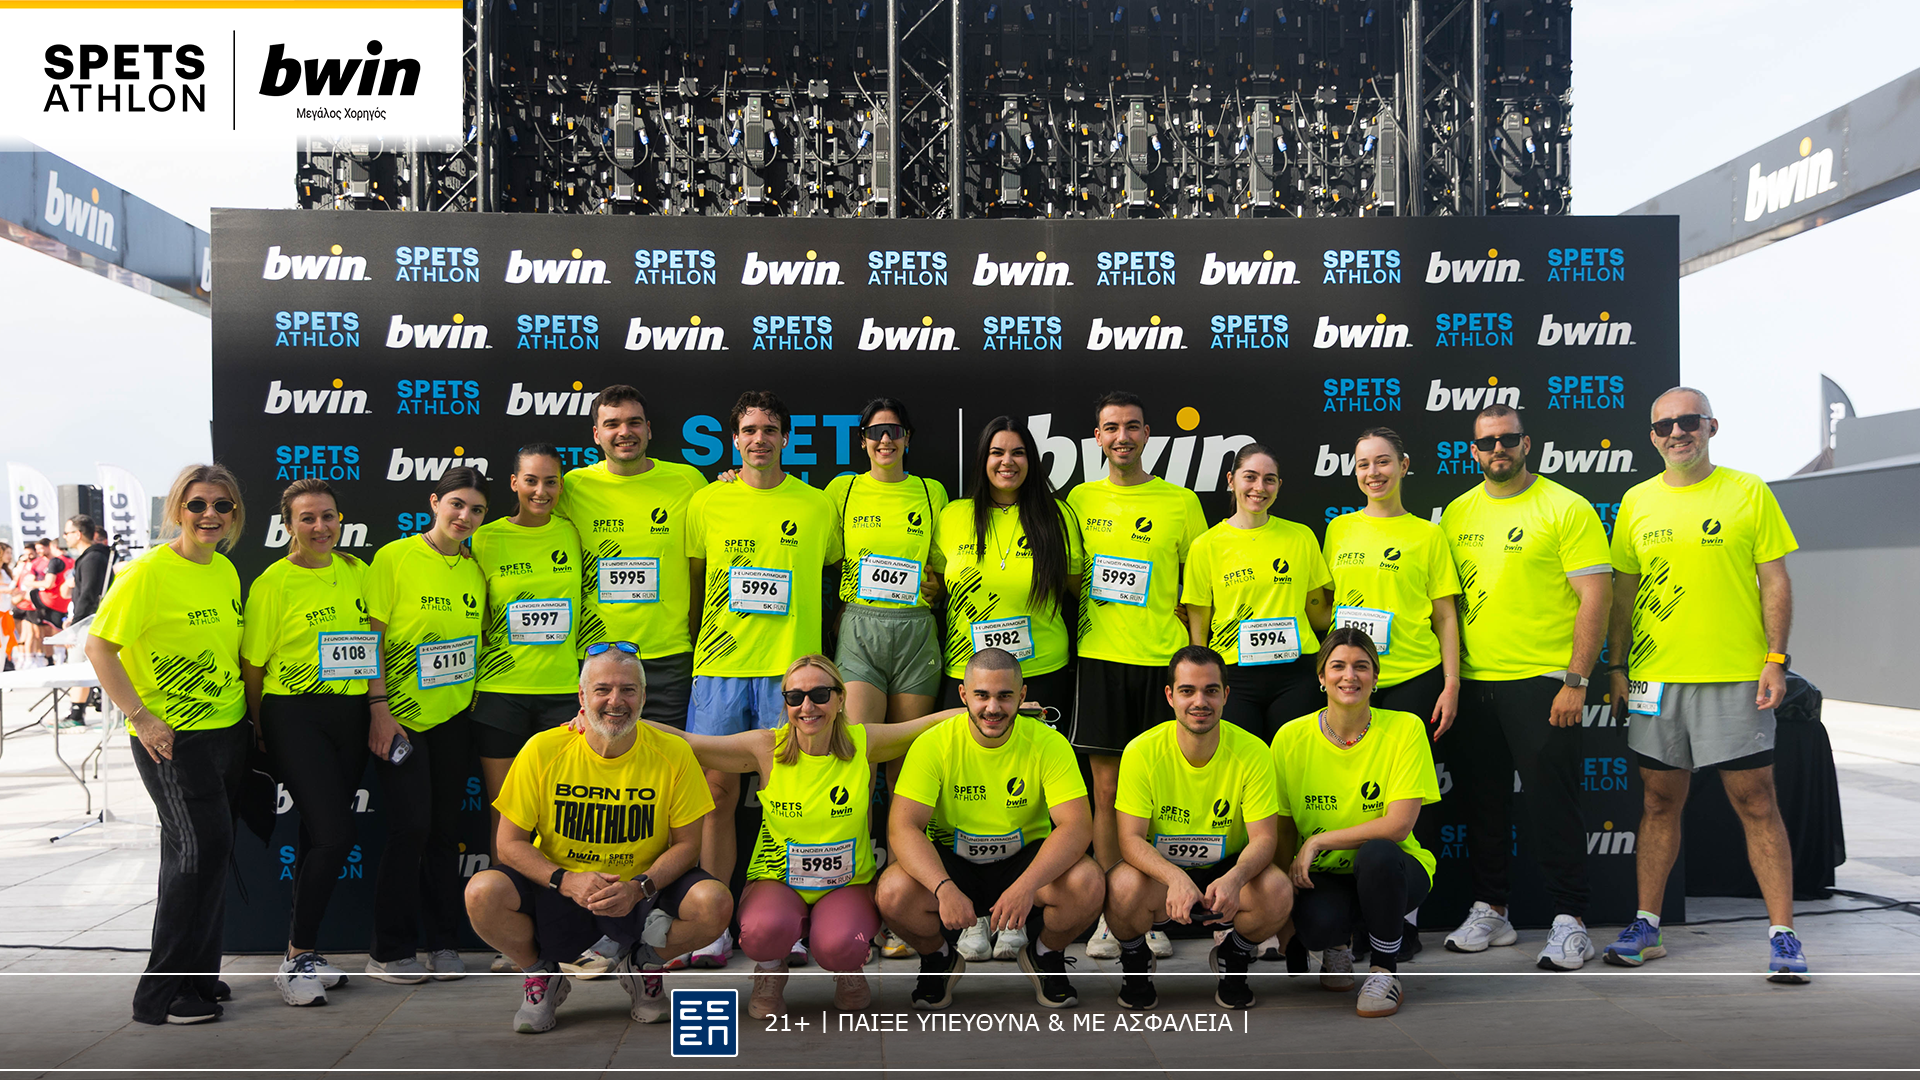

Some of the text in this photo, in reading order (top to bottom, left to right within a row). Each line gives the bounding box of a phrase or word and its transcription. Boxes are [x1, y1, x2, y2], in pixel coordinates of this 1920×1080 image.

[1744, 136, 1836, 222] bwin
[45, 170, 115, 250] bwin
[263, 245, 366, 280] bwin
[396, 246, 479, 266] SPETS
[635, 250, 715, 268] SPETS
[868, 251, 947, 270] SPETS
[1097, 251, 1175, 270] SPETS
[1324, 250, 1400, 268] SPETS
[1548, 248, 1624, 266] SPETS
[505, 249, 606, 284] bwin
[741, 250, 840, 285] bwin
[973, 251, 1069, 286] bwin
[1200, 250, 1296, 285] bwin
[1425, 249, 1520, 283] bwin
[396, 267, 479, 282] ATHLON
[635, 270, 715, 284] ATHLON
[868, 271, 947, 285] ATHLON
[1097, 271, 1175, 285] ATHLON
[1323, 269, 1400, 284] ATHLON
[1548, 267, 1624, 281] ATHLON
[276, 311, 359, 331] SPETS
[517, 315, 598, 333] SPETS
[753, 316, 832, 334] SPETS
[984, 316, 1061, 334] SPETS
[1211, 315, 1288, 333] SPETS
[1436, 313, 1512, 331] SPETS
[386, 314, 487, 348] bwin
[625, 316, 724, 350] bwin
[858, 316, 955, 350] bwin
[1087, 315, 1183, 350] bwin
[1313, 314, 1408, 348] bwin
[1538, 312, 1631, 346] bwin
[276, 332, 359, 347] ATHLON
[517, 335, 598, 349] ATHLON
[753, 336, 832, 350] ATHLON
[983, 336, 1061, 350] ATHLON
[1211, 334, 1288, 348] ATHLON
[1436, 332, 1512, 346] ATHLON
[398, 380, 479, 398] SPETS
[1324, 378, 1400, 396] SPETS
[1548, 376, 1624, 393] SPETS
[265, 379, 367, 414] bwin
[1548, 395, 1624, 409] ATHLON
[397, 400, 479, 414] ATHLON
[1324, 397, 1400, 412] ATHLON
[276, 446, 359, 464] SPETS
[1539, 439, 1632, 473] bwin
[276, 466, 359, 480] ATHLON
[593, 519, 624, 527] SPETS
[852, 515, 882, 524] SPETS
[1086, 518, 1113, 527] SPETS
[650, 525, 670, 533] bwin
[1642, 528, 1673, 541] SPETS
[724, 539, 756, 548] SPETS
[780, 537, 799, 545] bwin
[1131, 532, 1151, 542] bwin
[1457, 533, 1485, 542] SPETS
[1701, 537, 1724, 545] bwin
[1337, 552, 1365, 560] SPETS
[499, 562, 532, 573] SPETS
[1379, 561, 1399, 571] bwin
[609, 570, 646, 585] 5995
[871, 568, 908, 586] 6067
[1102, 569, 1136, 586] 5993
[1223, 567, 1254, 581] SPETS
[1225, 574, 1256, 588] ATHLON
[1273, 575, 1292, 583] bwin
[741, 580, 778, 596] 5996
[421, 596, 451, 606] SPETS
[187, 608, 218, 620] SPETS
[305, 606, 336, 621] SPETS
[521, 611, 559, 626] 5997
[984, 630, 1021, 647] 5982
[1249, 631, 1287, 647] 5994
[332, 646, 366, 661] 6108
[433, 651, 466, 670] 6110
[555, 783, 656, 801] BORN TO
[953, 784, 986, 795] SPETS
[953, 793, 987, 802] ATHLON
[1006, 797, 1027, 807] bwin
[1304, 795, 1337, 804] SPETS
[770, 800, 802, 811] SPETS
[770, 808, 803, 818] ATHLON
[830, 807, 853, 817] bwin
[1160, 805, 1190, 818] SPETS
[1305, 803, 1338, 811] ATHLON
[1362, 801, 1384, 811] bwin
[554, 800, 655, 844] TRIATHLON
[1158, 814, 1190, 825] ATHLON
[1212, 818, 1233, 828] bwin
[567, 849, 601, 861] bwin
[968, 844, 1006, 856] 5991
[1168, 844, 1209, 859] 5992
[801, 856, 842, 872] 5985
